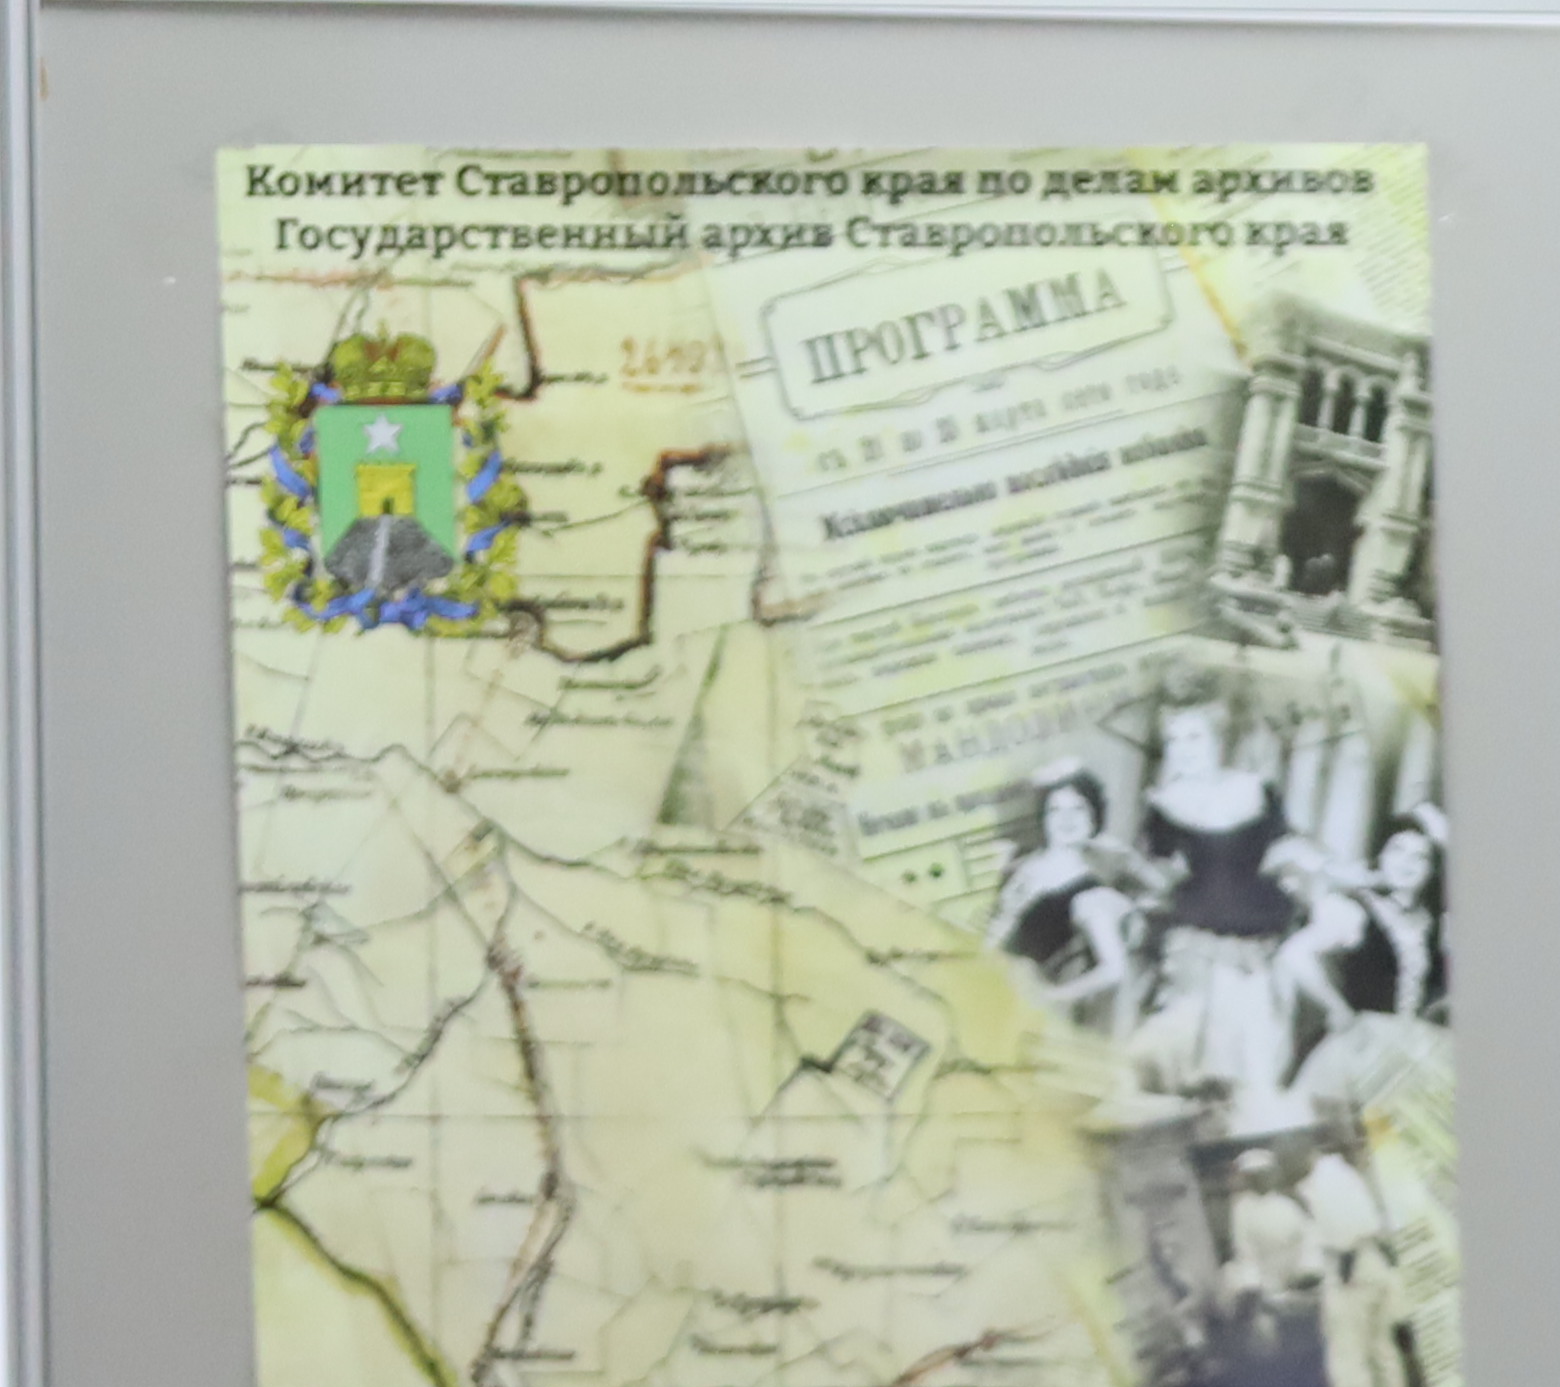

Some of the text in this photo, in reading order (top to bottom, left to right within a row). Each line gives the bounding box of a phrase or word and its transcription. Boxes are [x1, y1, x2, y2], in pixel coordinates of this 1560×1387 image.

[245, 162, 1376, 205] Комитет Ставропольского края по делам архивов
[275, 212, 1348, 260] Государственный архив Ставропольского края
[800, 266, 1128, 385] ПРОГРАММА
